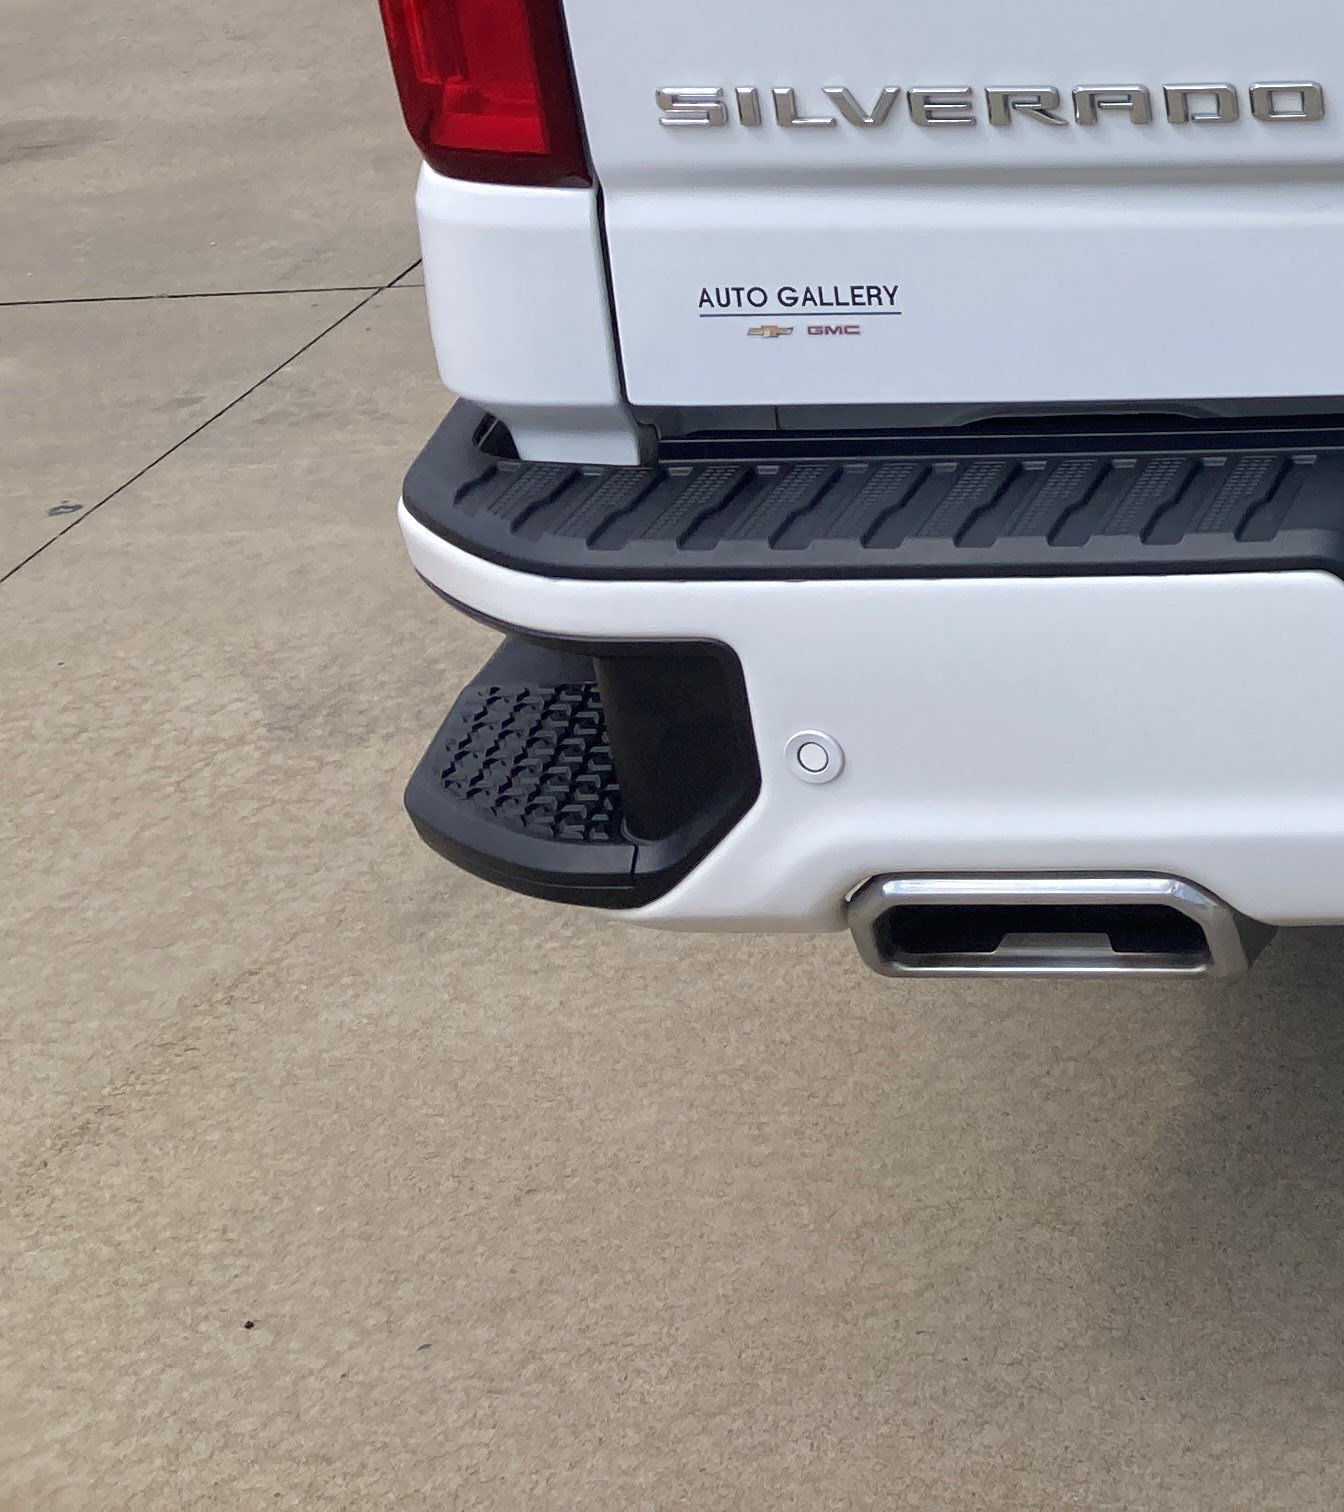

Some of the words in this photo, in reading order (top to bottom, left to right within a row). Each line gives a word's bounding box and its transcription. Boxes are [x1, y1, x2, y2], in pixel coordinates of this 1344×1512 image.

[655, 80, 1326, 128] SILVERADO
[698, 286, 768, 308] AUTO
[776, 285, 899, 308] GALLERY
[807, 324, 861, 336] GMC
